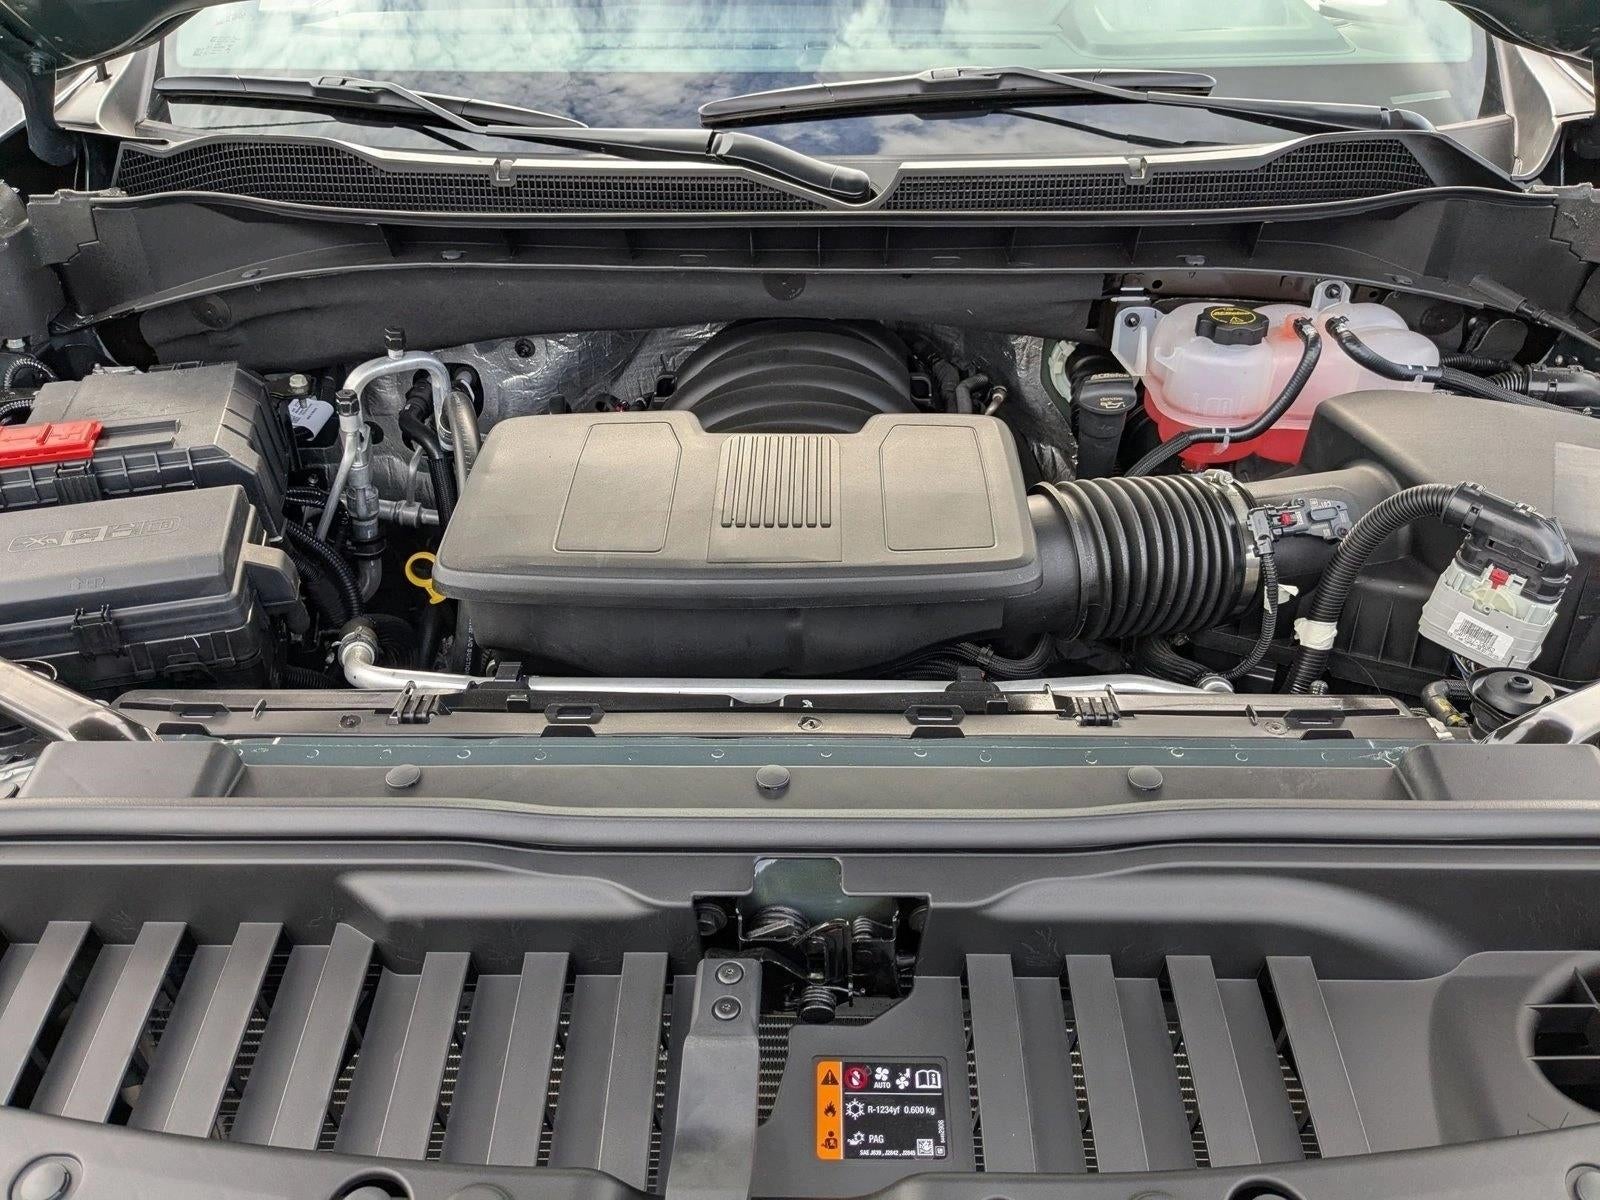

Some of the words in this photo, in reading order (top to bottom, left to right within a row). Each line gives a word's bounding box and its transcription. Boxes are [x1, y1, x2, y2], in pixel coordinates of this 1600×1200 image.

[867, 1105, 900, 1115] R-1234yf
[903, 1106, 925, 1114] 0.600
[925, 1106, 935, 1115] kg
[868, 1134, 885, 1144] PAG
